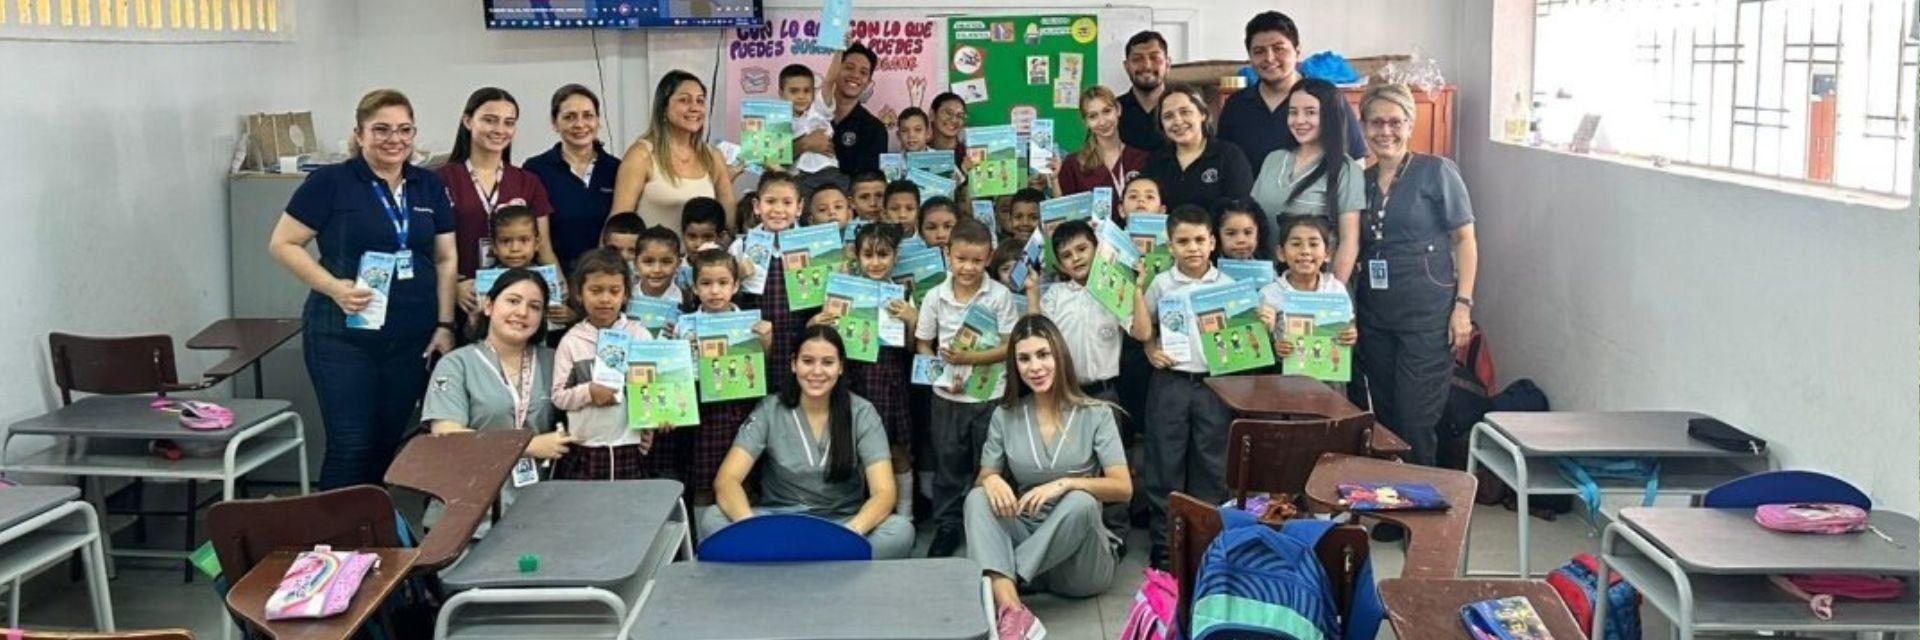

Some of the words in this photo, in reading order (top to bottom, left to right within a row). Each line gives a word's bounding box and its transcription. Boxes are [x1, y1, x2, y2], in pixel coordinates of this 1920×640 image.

[779, 19, 799, 38] LO
[884, 20, 901, 37] LO
[905, 20, 933, 38] QUE
[730, 40, 785, 60] PUEDES
[868, 38, 923, 55] PUEDES
